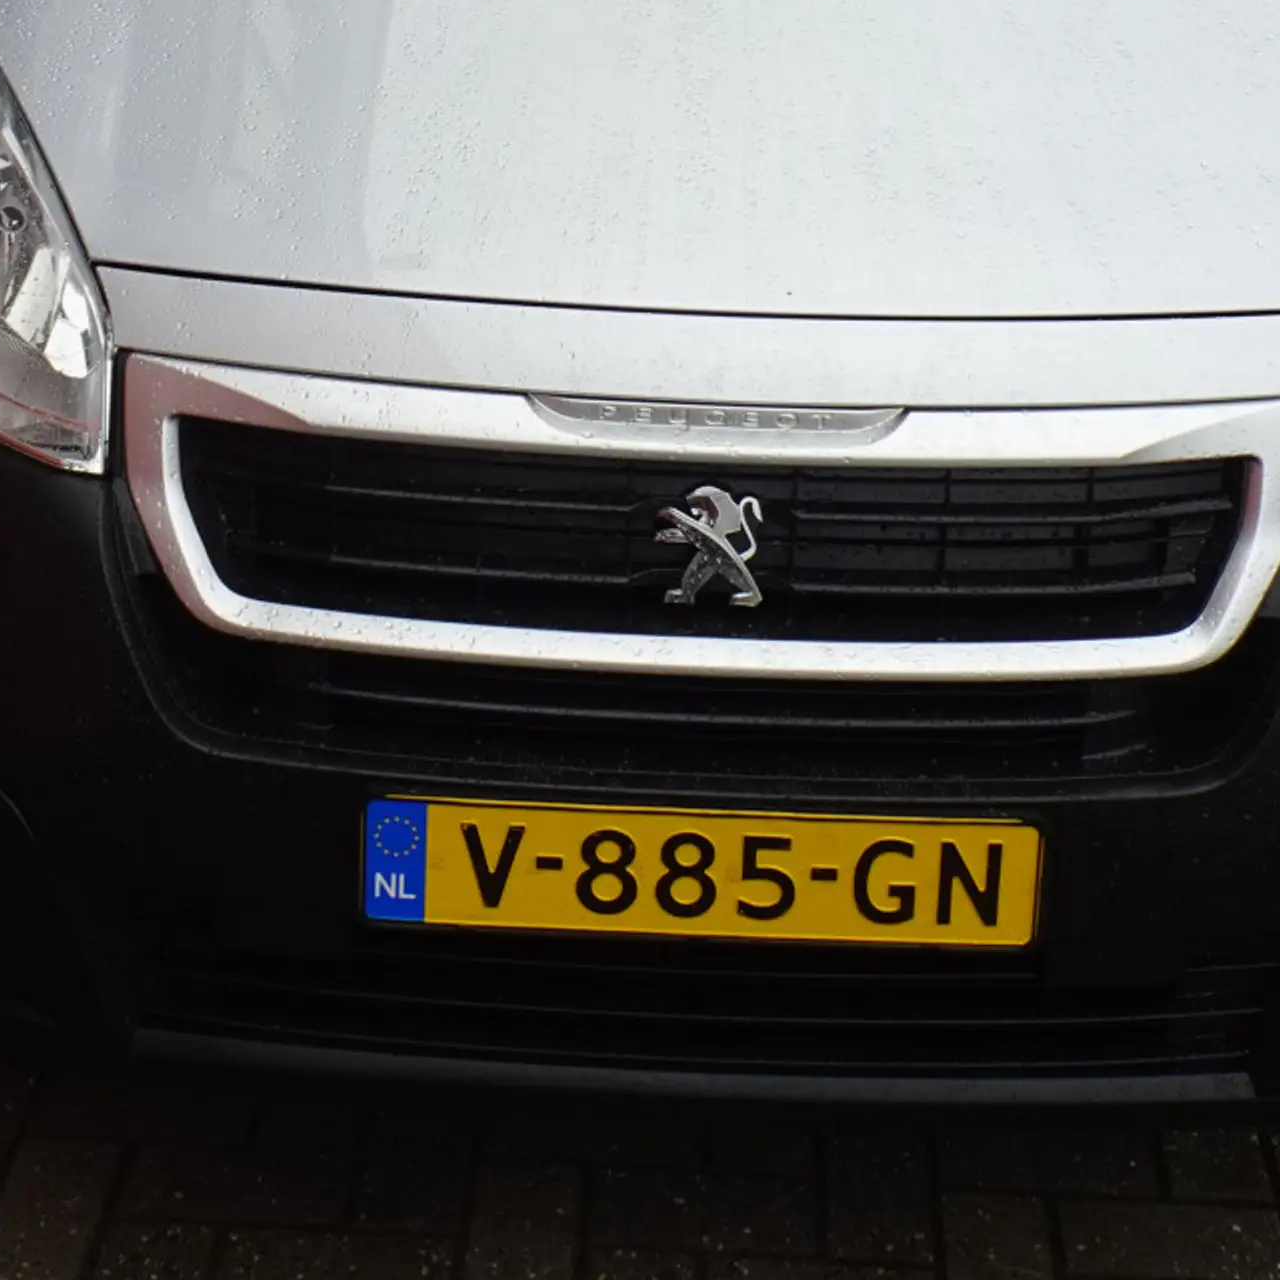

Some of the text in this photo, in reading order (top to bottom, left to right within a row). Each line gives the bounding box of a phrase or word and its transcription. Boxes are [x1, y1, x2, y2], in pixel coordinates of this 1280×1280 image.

[600, 404, 832, 430] PEUGEOT
[373, 871, 417, 900] NL
[460, 821, 1004, 927] V-885-GN
